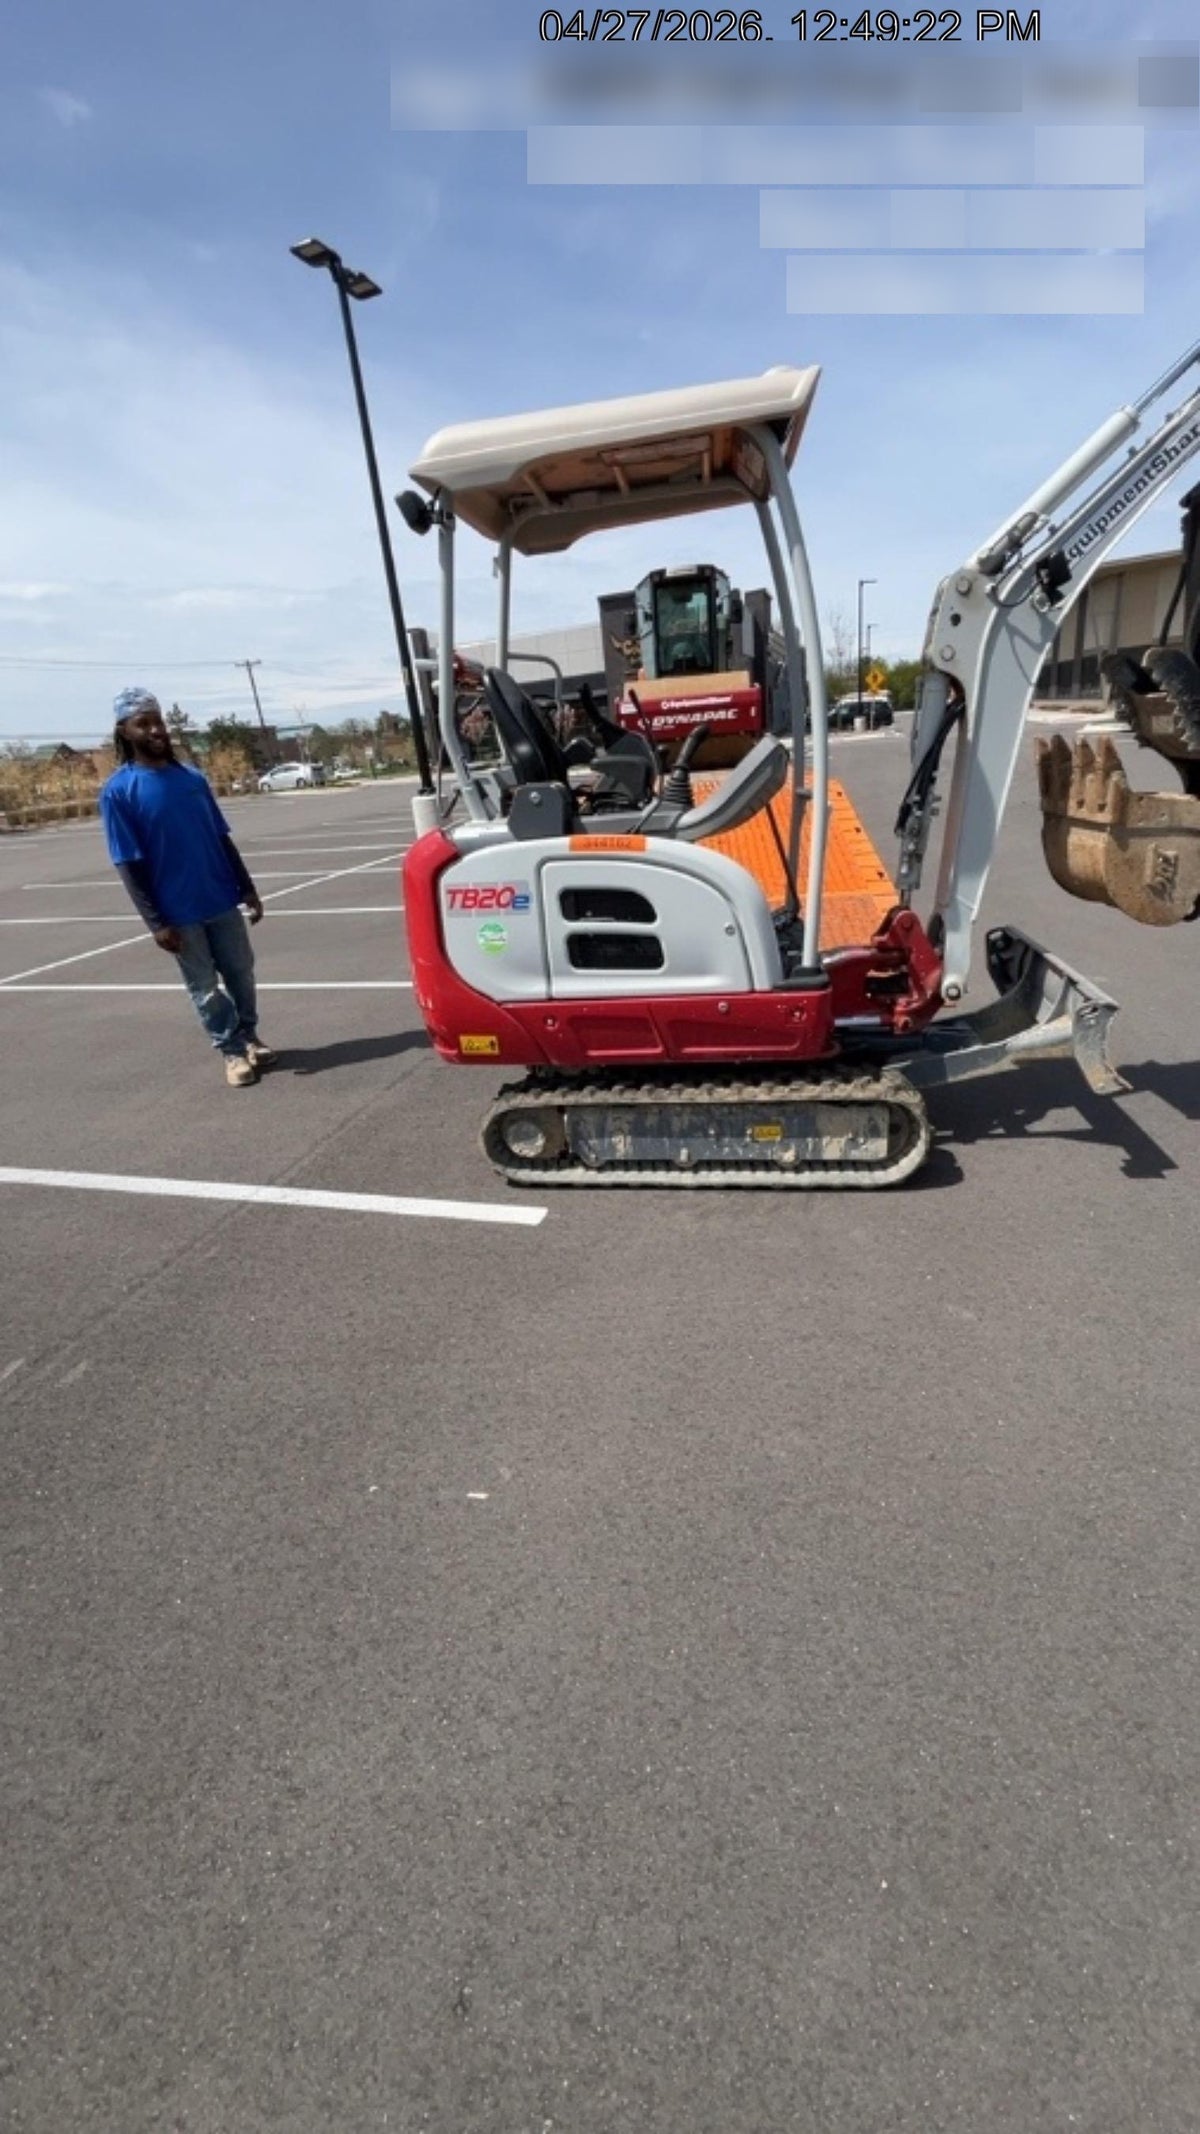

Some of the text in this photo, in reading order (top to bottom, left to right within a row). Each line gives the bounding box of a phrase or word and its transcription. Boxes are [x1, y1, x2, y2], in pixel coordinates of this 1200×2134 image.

[1067, 423, 1200, 558] quipmentShar
[652, 708, 738, 727] DYNAPAC
[447, 886, 530, 910] TB20e
